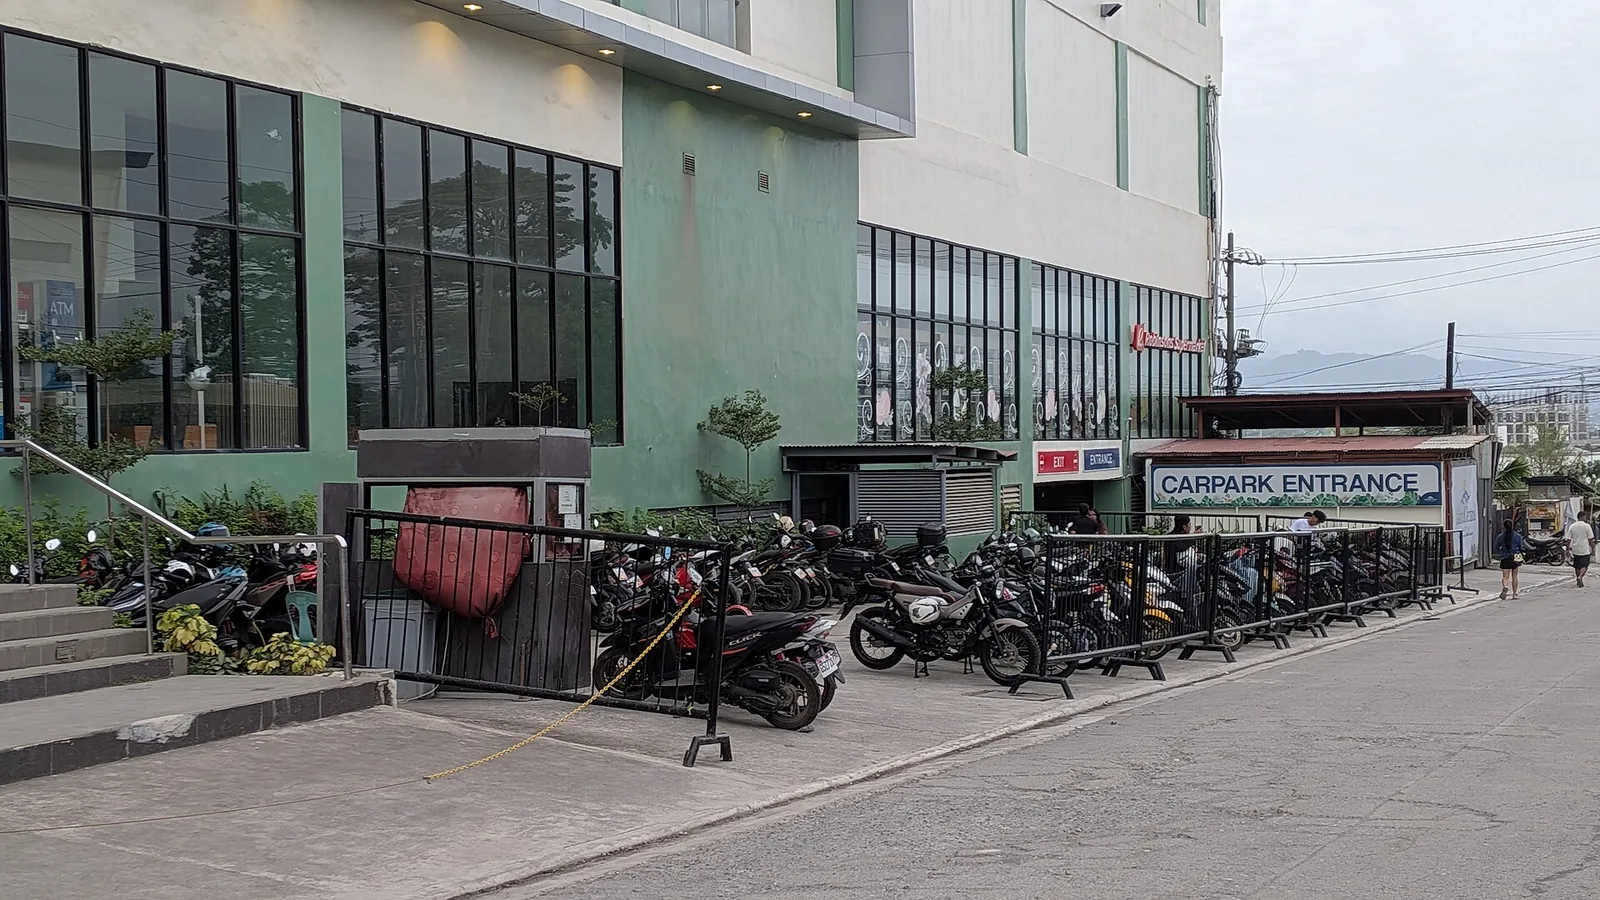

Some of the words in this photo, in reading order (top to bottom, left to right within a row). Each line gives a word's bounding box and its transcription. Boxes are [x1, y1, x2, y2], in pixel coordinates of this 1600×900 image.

[50, 301, 74, 316] ATM
[1053, 456, 1065, 468] EXIT
[1089, 453, 1113, 466] ENTRANCE
[1161, 474, 1275, 494] CARPARK
[1282, 473, 1419, 493] ENTRANCE
[729, 631, 763, 646] CLICK
